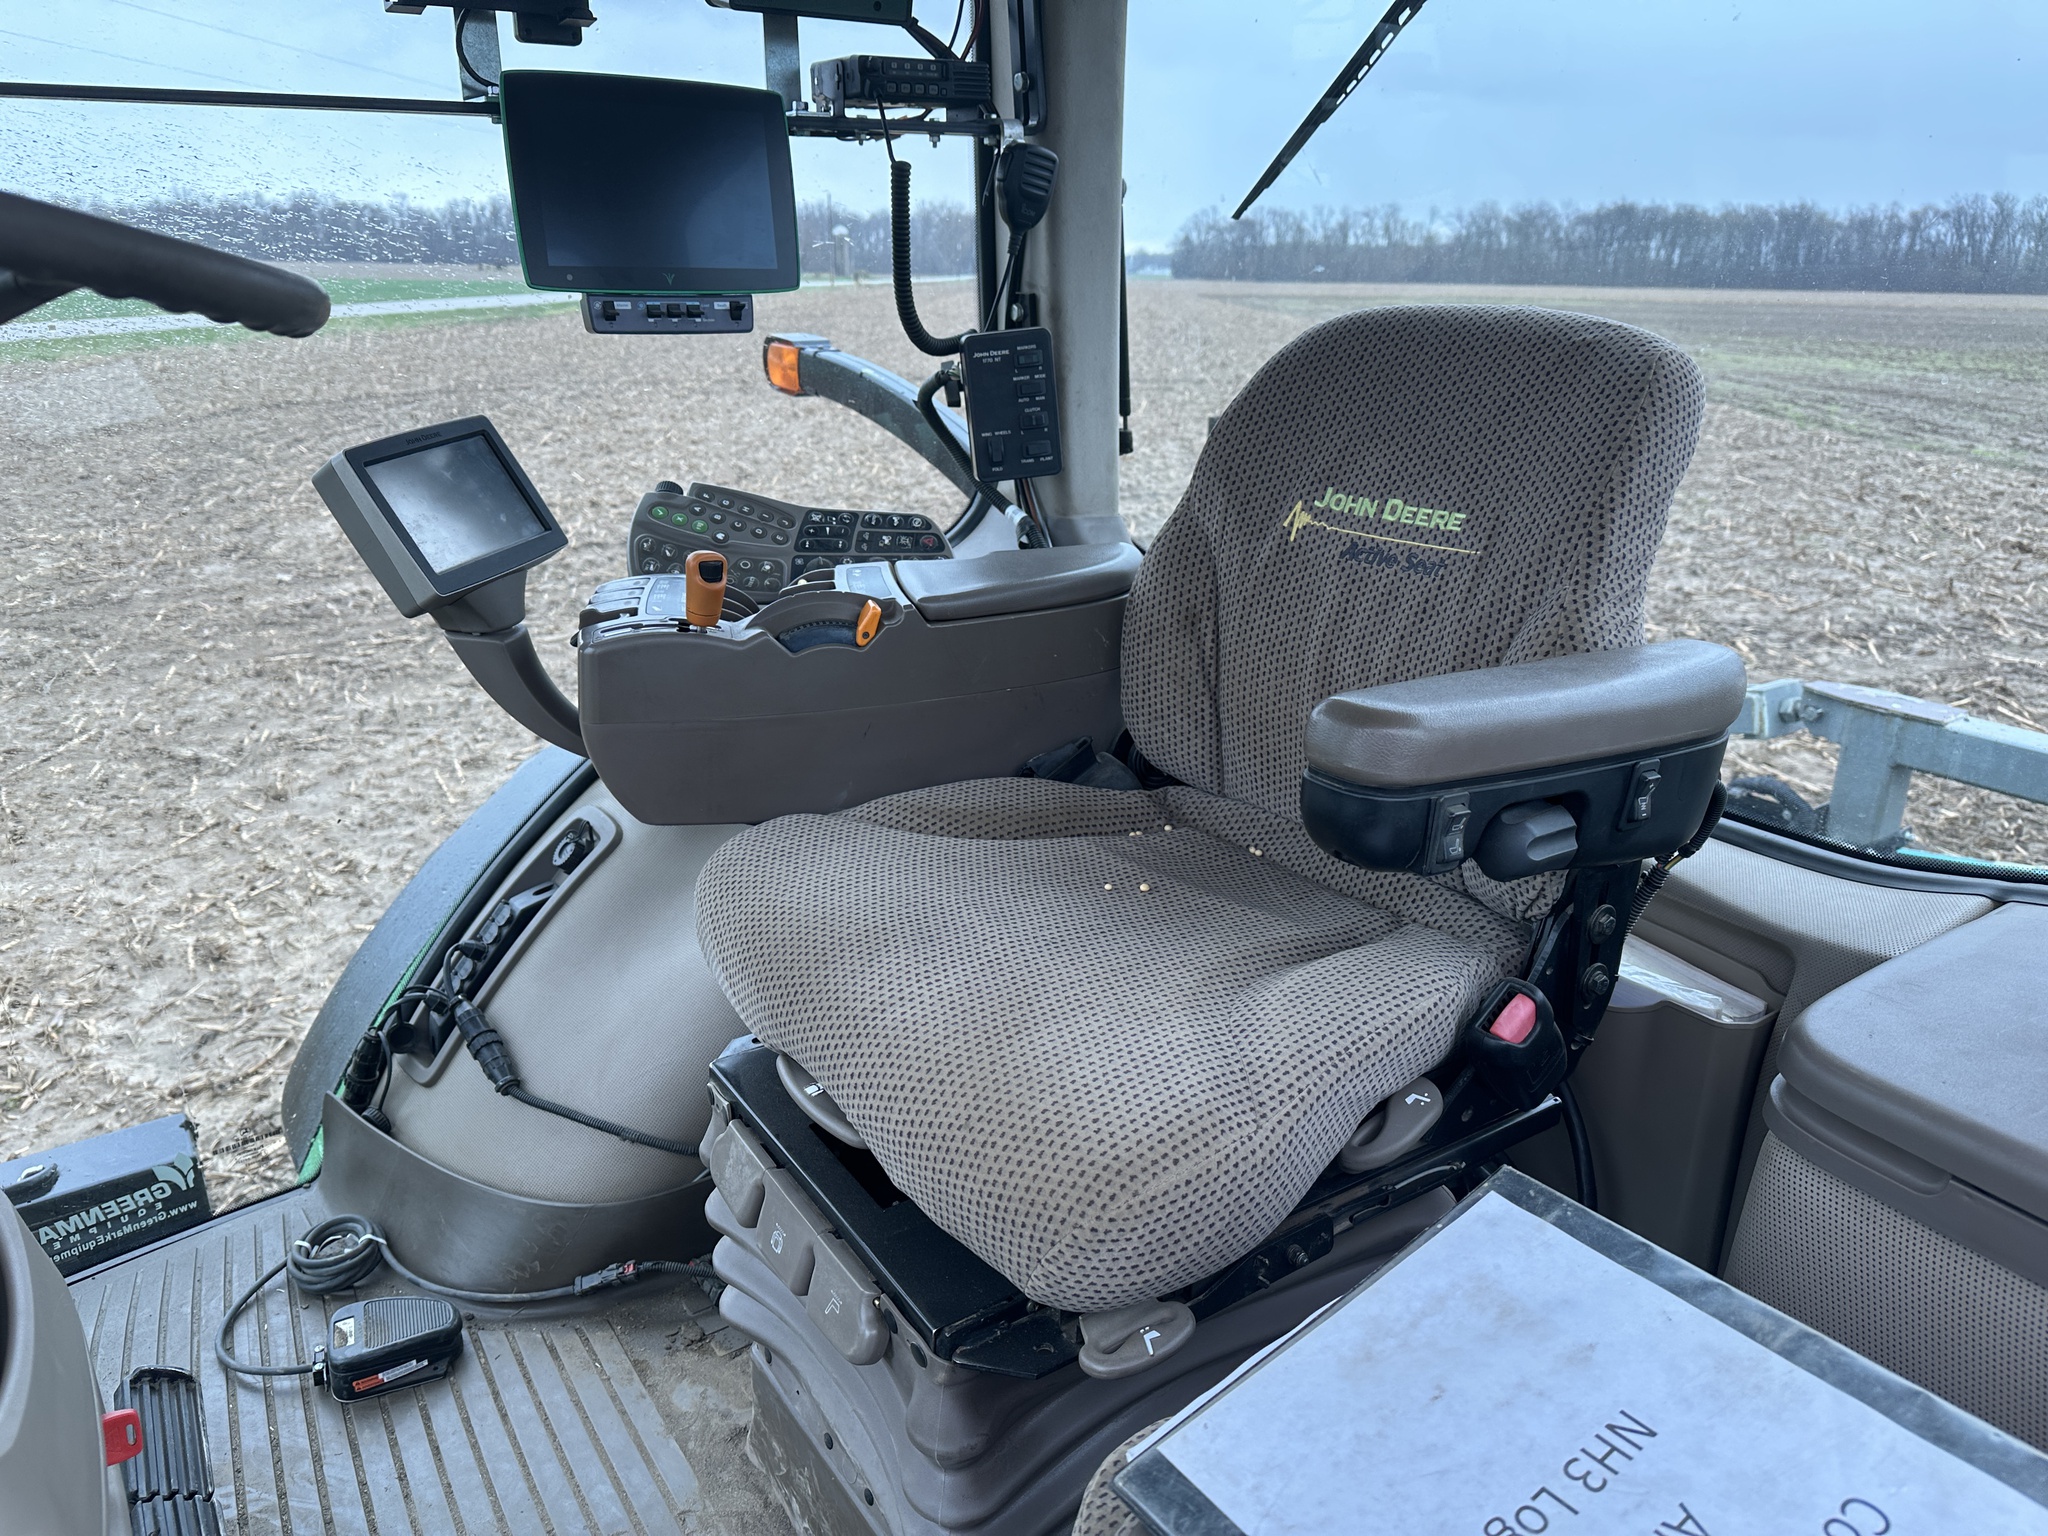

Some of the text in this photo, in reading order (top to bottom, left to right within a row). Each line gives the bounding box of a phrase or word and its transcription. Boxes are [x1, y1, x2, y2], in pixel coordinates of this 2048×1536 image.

[1314, 486, 1466, 531] JOHN DEERE
[1339, 541, 1449, 578] Active Seat
[1563, 1409, 1658, 1493] NH3
[1653, 1502, 1712, 1536] A
